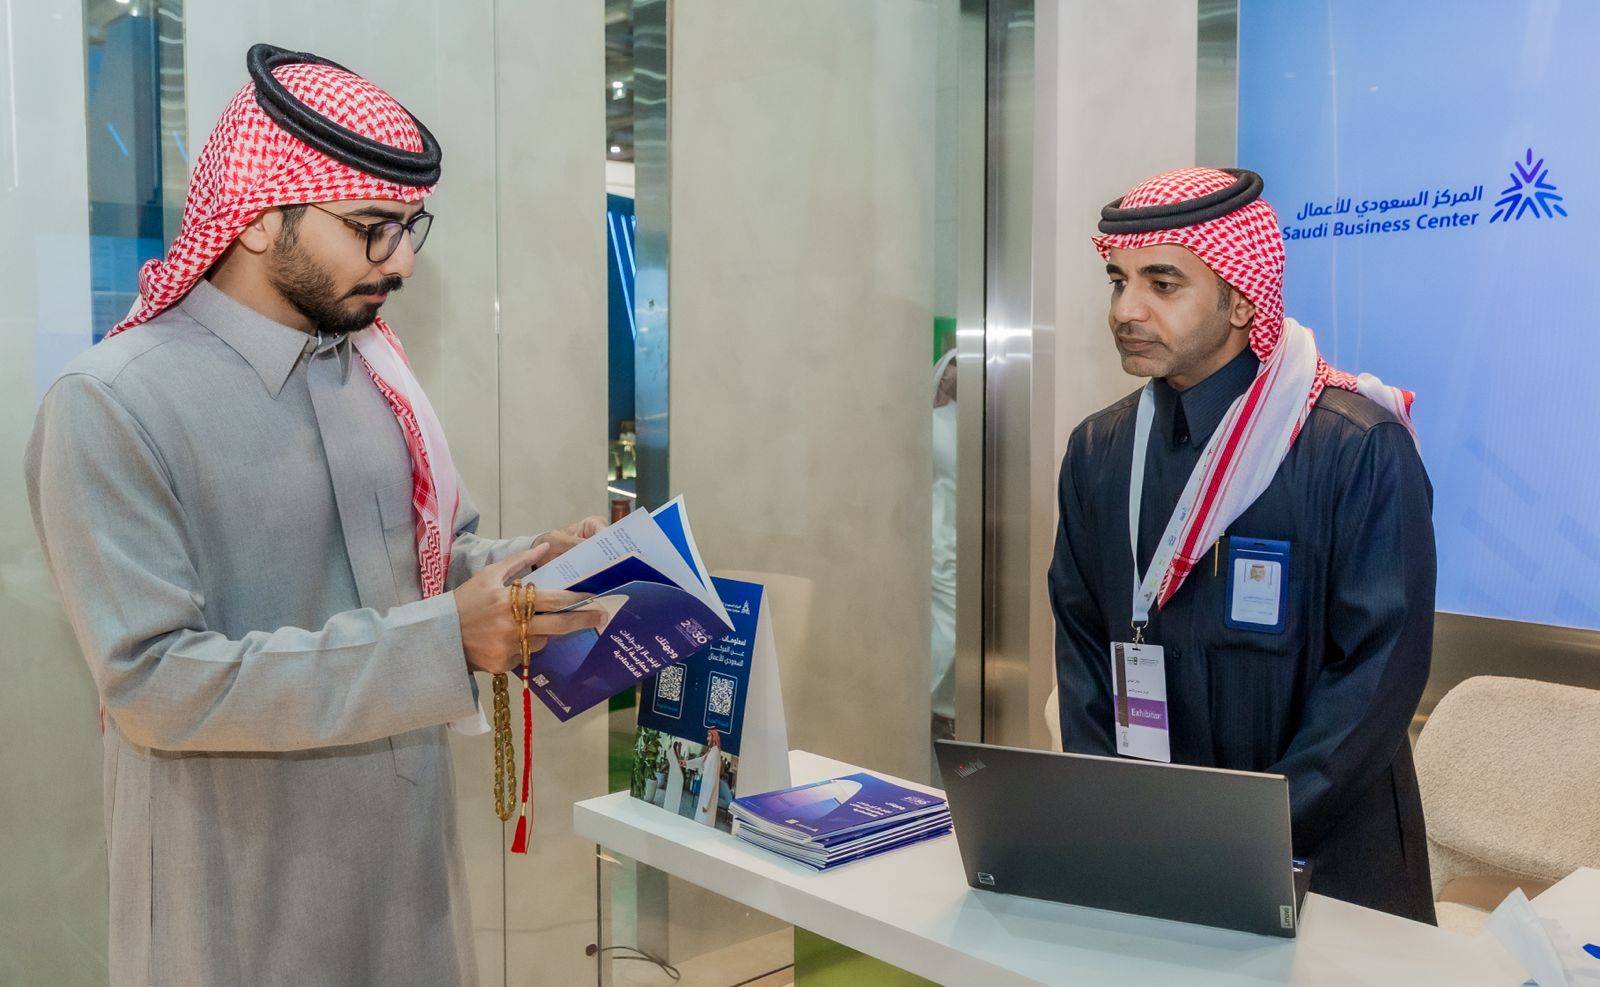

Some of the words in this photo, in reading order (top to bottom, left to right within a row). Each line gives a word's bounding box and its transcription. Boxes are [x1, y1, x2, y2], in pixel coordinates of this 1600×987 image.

[1296, 197, 1351, 221] للأعمال
[1355, 190, 1429, 218] السعودي
[1432, 185, 1484, 209] المركز
[1282, 223, 1328, 241] Saudi
[1333, 217, 1410, 237] Business
[1416, 211, 1480, 230] Center
[680, 620, 708, 644] 2030
[655, 635, 679, 659] وجهتك
